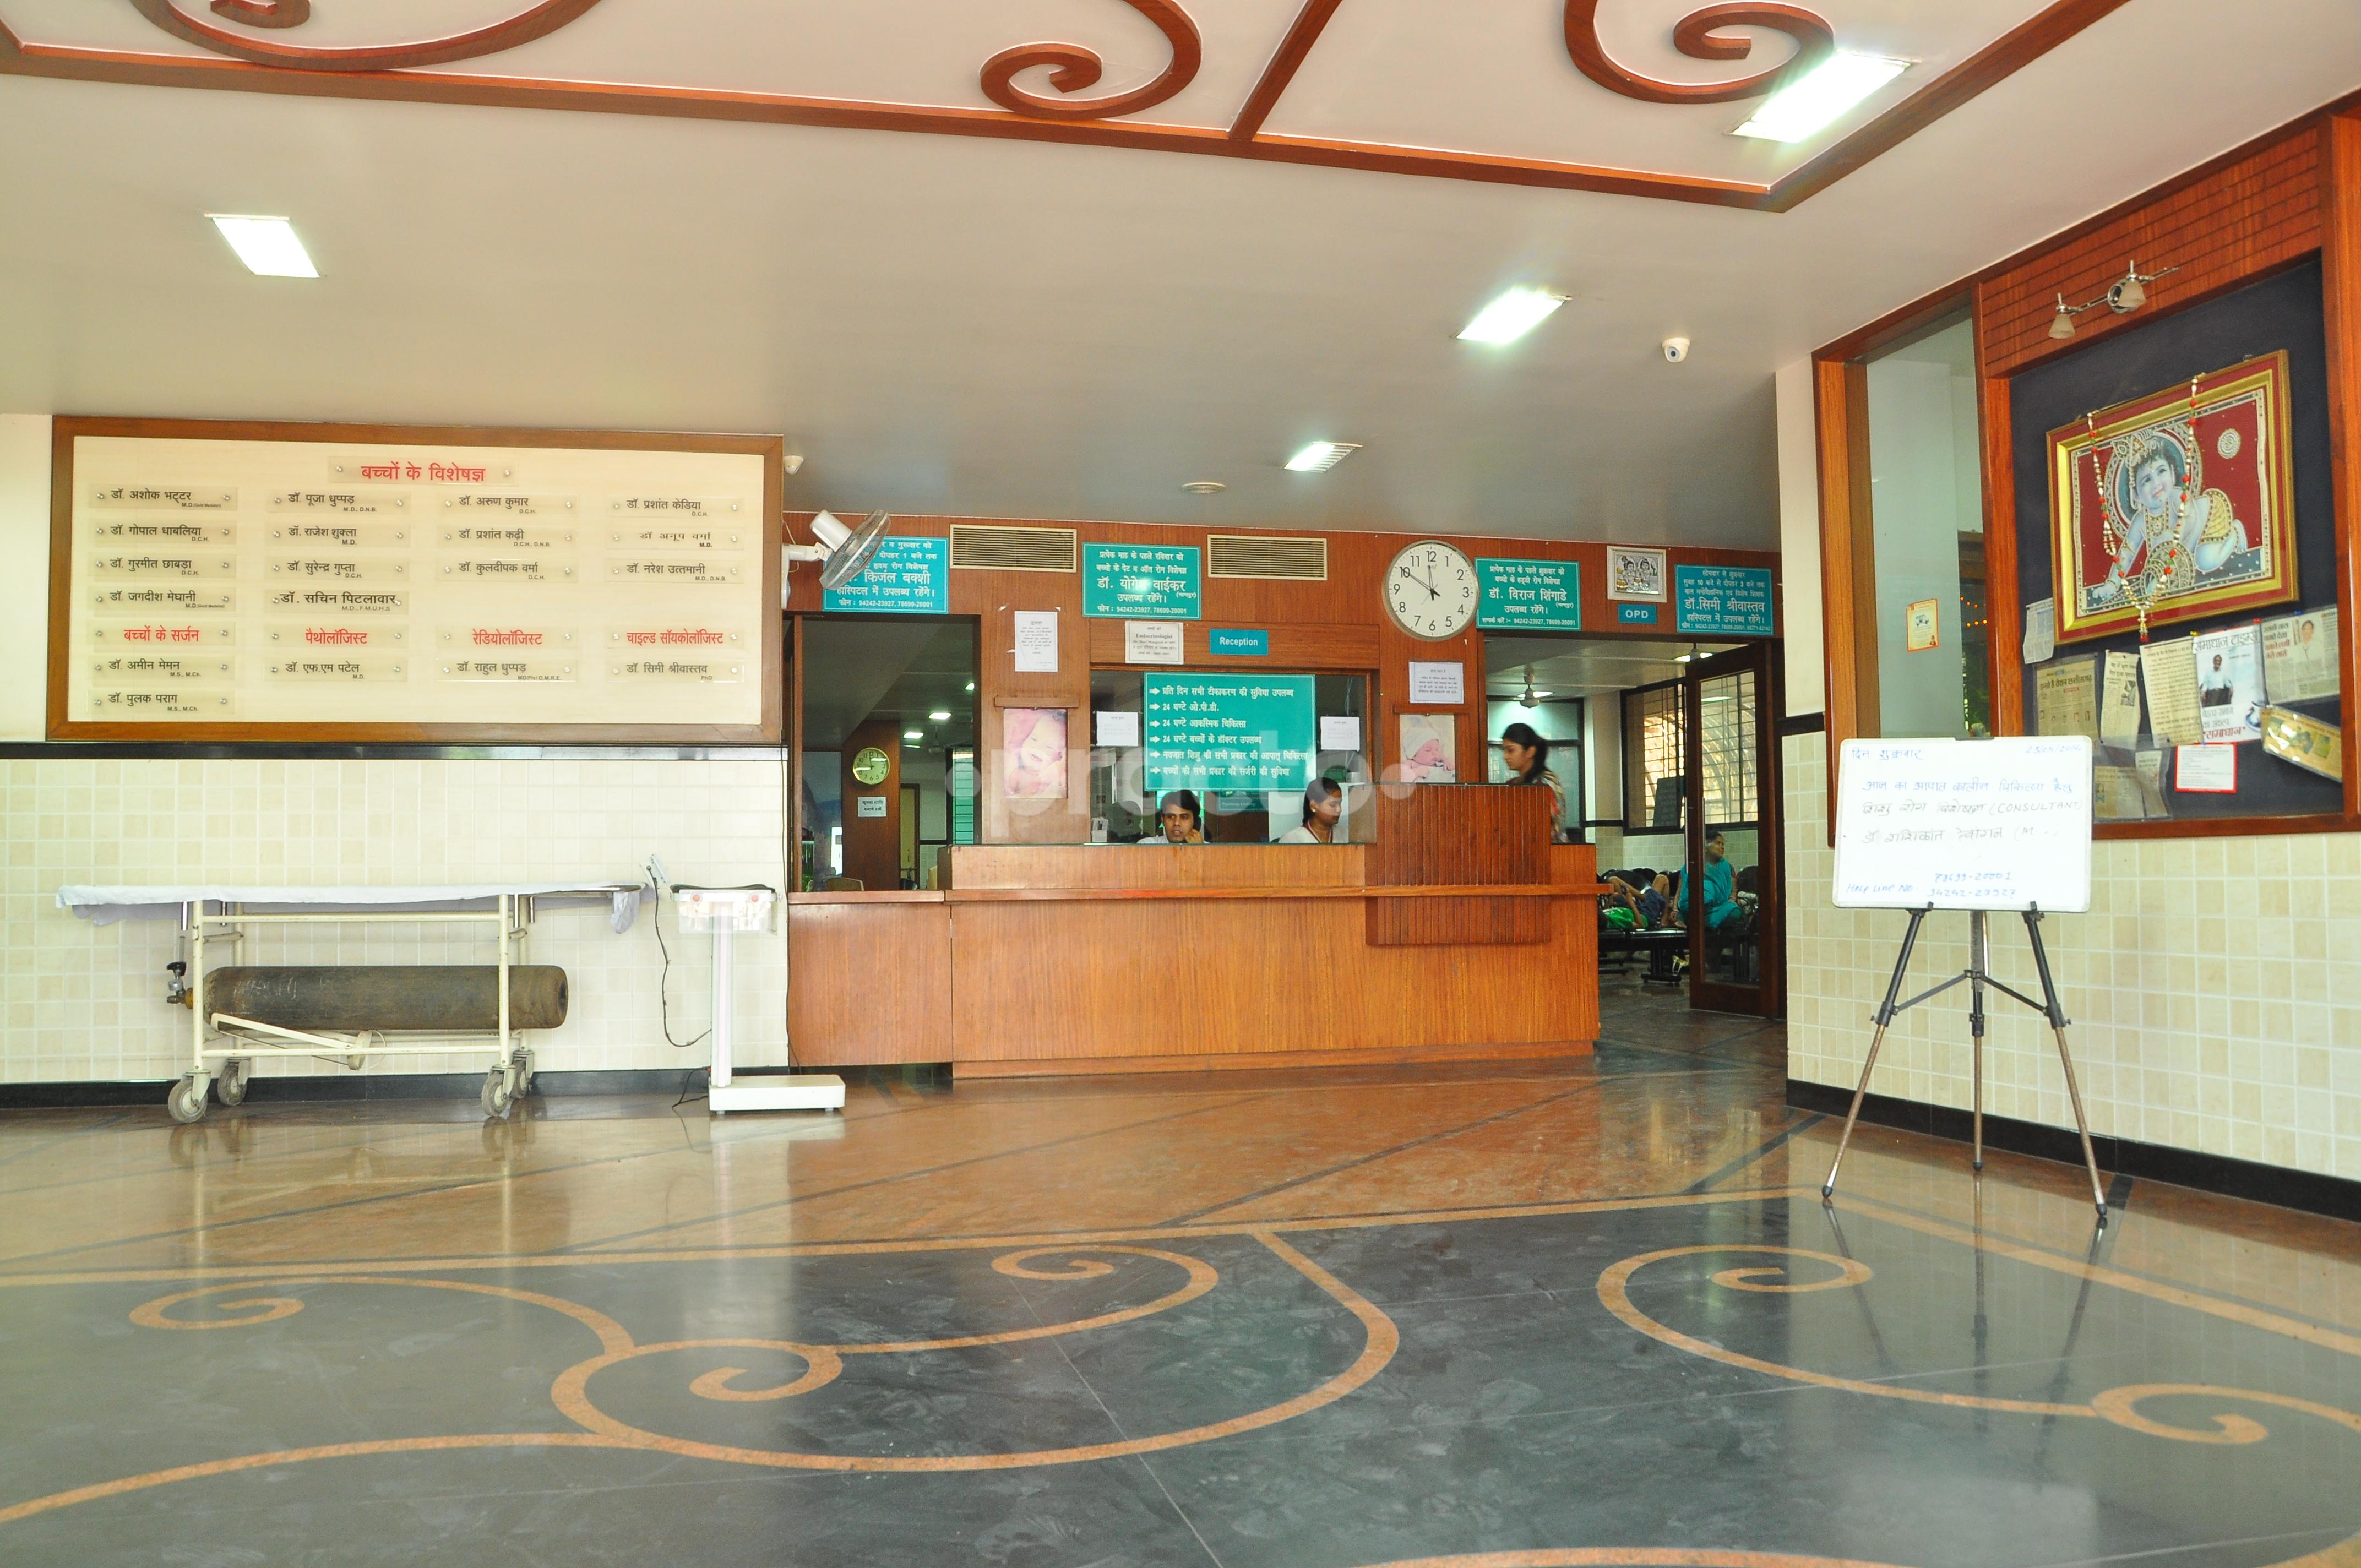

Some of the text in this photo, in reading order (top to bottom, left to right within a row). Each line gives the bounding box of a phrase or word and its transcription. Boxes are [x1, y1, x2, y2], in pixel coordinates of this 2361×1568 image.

[361, 461, 486, 482] बच्चों के विशेषज्ञ
[129, 488, 160, 499] अशोक
[306, 494, 325, 506] पूजा
[505, 497, 529, 509] कुमार
[644, 498, 669, 510] प्रशांत
[672, 498, 701, 510] केडिया
[129, 523, 157, 535] गोपाल
[304, 526, 329, 536] राजेश
[331, 528, 357, 539] शुक्ला
[476, 527, 502, 540] प्रशांत
[1410, 556, 1420, 567] 11
[1426, 551, 1437, 562] 12
[1445, 556, 1449, 567] 1
[128, 556, 158, 571] गुरमीत
[305, 560, 330, 575] सुरेन्द्र
[334, 563, 355, 575] गुप्ता
[476, 560, 518, 575] कुलदीपक
[521, 562, 538, 573] वर्मा
[644, 562, 664, 574] नरेश
[1457, 569, 1464, 580] 2
[1153, 576, 1187, 592] वाईकर
[1393, 584, 1401, 595] 9
[128, 589, 163, 601] जगदीश
[167, 589, 196, 602] मेघानी
[303, 591, 396, 604] सचिन पिटलावार
[1462, 587, 1470, 598] 3
[1509, 587, 1536, 601] विराज
[1399, 601, 1406, 613] 8
[1457, 603, 1465, 615] 4
[1727, 597, 1765, 612] श्रीवास्तव
[1625, 609, 1649, 619] OPD
[1413, 616, 1421, 627] 7
[1429, 620, 1436, 631] 6
[1445, 616, 1452, 628] 5
[123, 625, 199, 641] बच्चों के सर्जन
[305, 627, 368, 644] पैथोलॉजिस्ट
[472, 628, 542, 645] रेडियोलॉजिस्ट
[627, 632, 656, 646] चाइल्ड
[1219, 636, 1258, 647] Reception
[127, 658, 154, 669] अमीन
[159, 658, 180, 670] मेमन
[338, 661, 360, 672] पटेल
[475, 663, 497, 675] राहुल
[644, 662, 664, 673] सिमी
[668, 662, 708, 674] श्रीवास्तव
[127, 694, 151, 706] पुलक
[156, 694, 178, 703] पराग
[1162, 719, 1171, 727] 24
